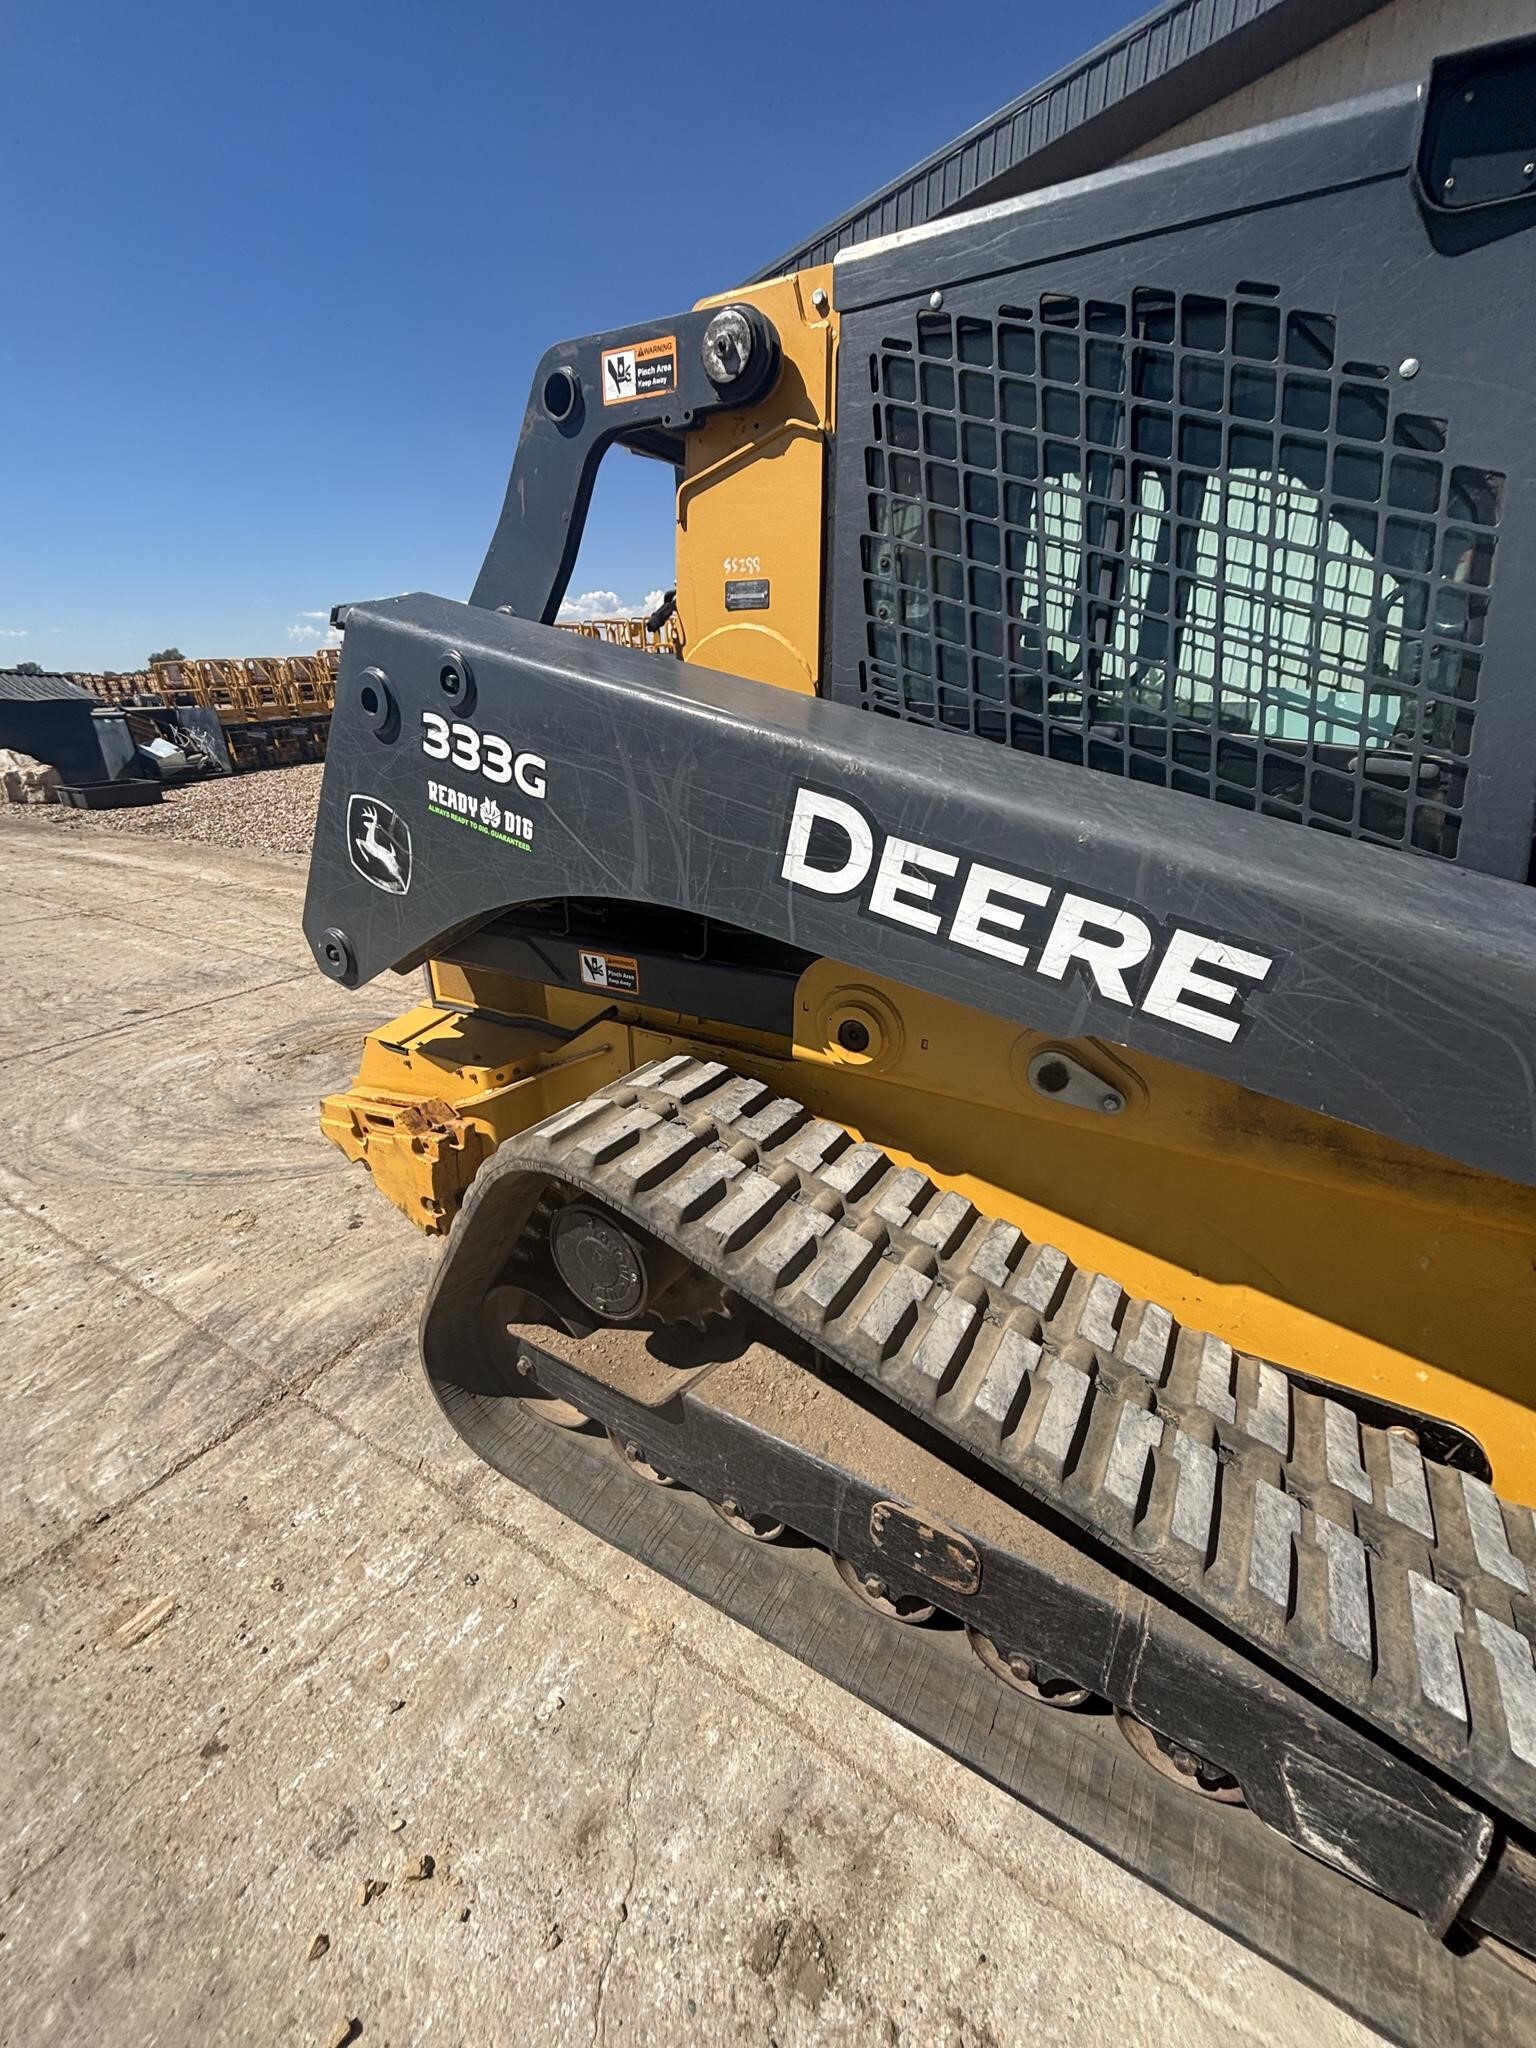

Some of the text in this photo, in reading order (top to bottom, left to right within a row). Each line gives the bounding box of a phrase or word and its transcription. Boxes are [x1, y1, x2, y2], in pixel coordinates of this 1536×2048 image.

[637, 363, 672, 378] Pinch Area
[643, 342, 673, 355] WARNING
[638, 376, 667, 388] Keep Away
[422, 712, 546, 799] 333G
[428, 780, 534, 841] READY DIG
[428, 804, 532, 853] ALWAYS READY TO DIG. GUARANTEED.
[781, 787, 1273, 1044] DEERE
